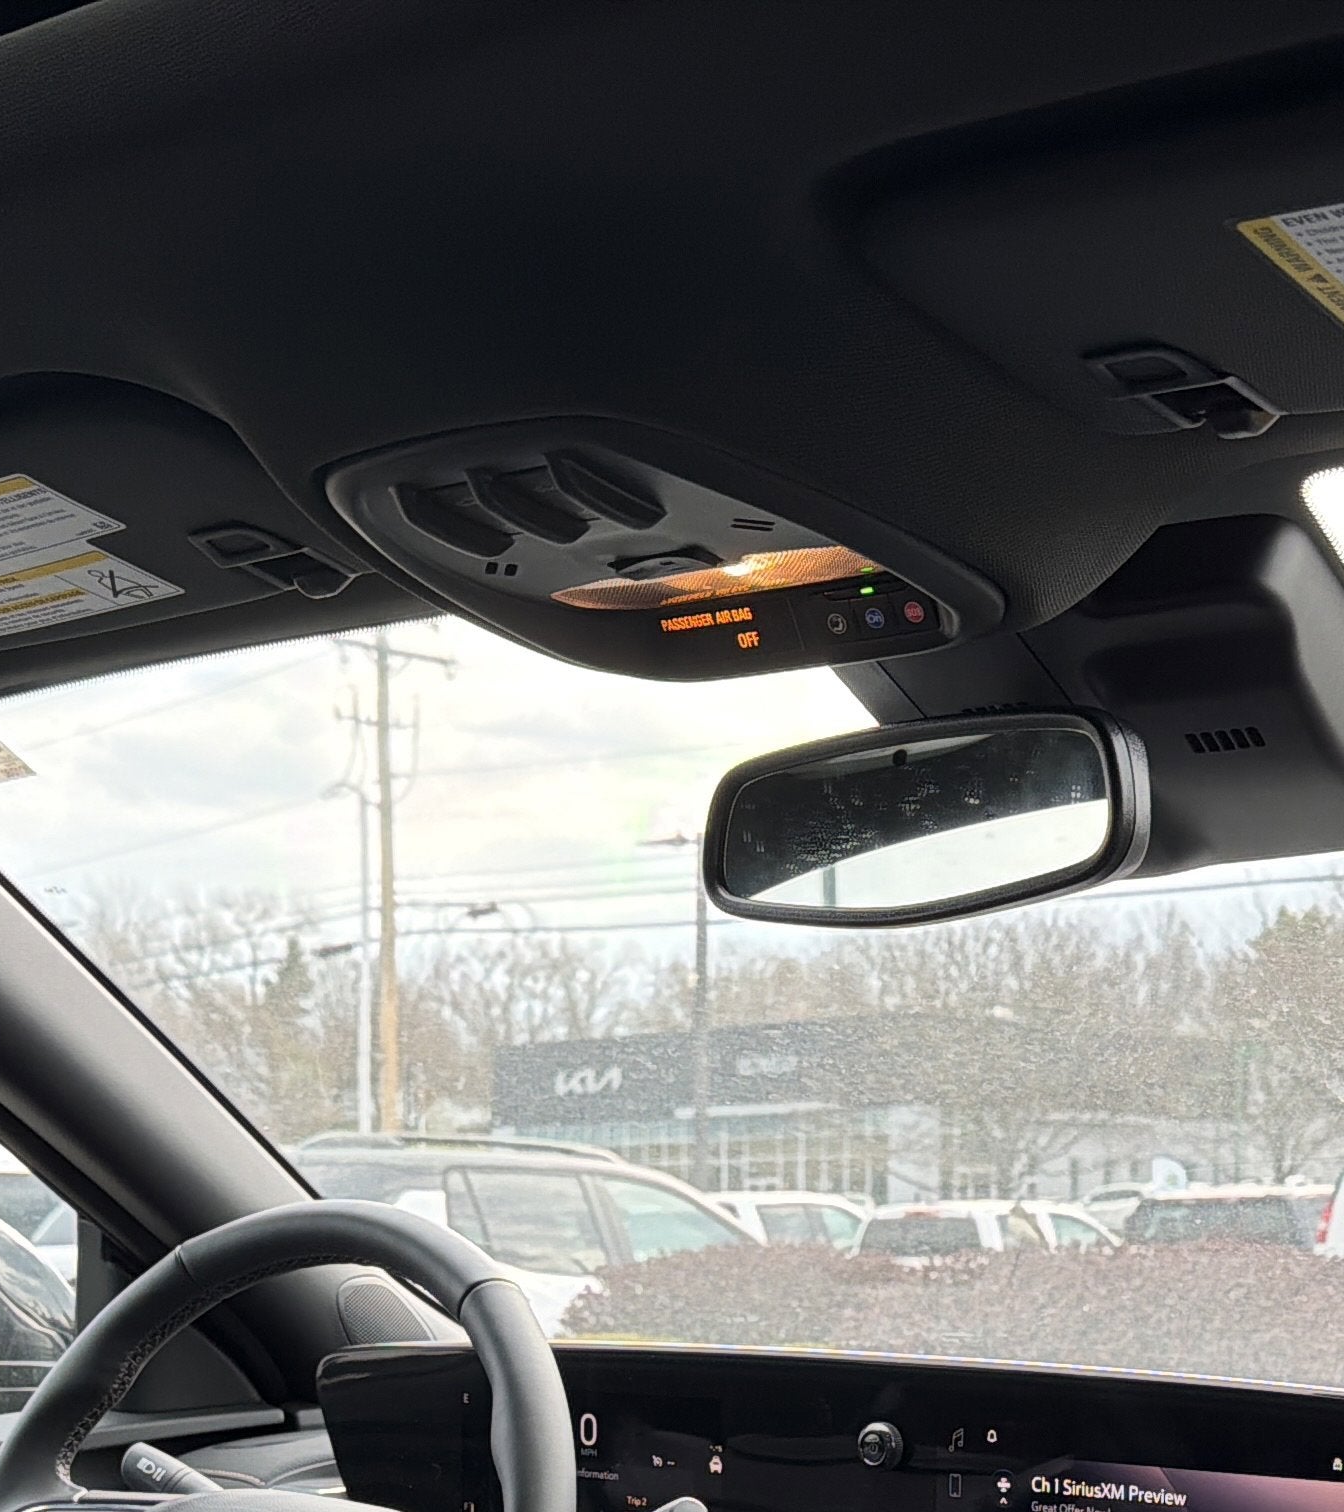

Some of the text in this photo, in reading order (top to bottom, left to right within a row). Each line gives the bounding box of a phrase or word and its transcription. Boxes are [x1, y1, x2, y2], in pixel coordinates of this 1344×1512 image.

[1279, 211, 1331, 227] EVEN
[660, 606, 753, 632] PASSENGER AIR BAG
[737, 631, 760, 649] OFF
[554, 1064, 622, 1098] KIA
[580, 1413, 598, 1446] 0
[580, 1448, 598, 1457] MPH
[625, 1495, 648, 1507] Trip 2
[1031, 1476, 1051, 1493] Ch
[1062, 1479, 1125, 1501] SiriusXM
[1128, 1485, 1187, 1507] Preview
